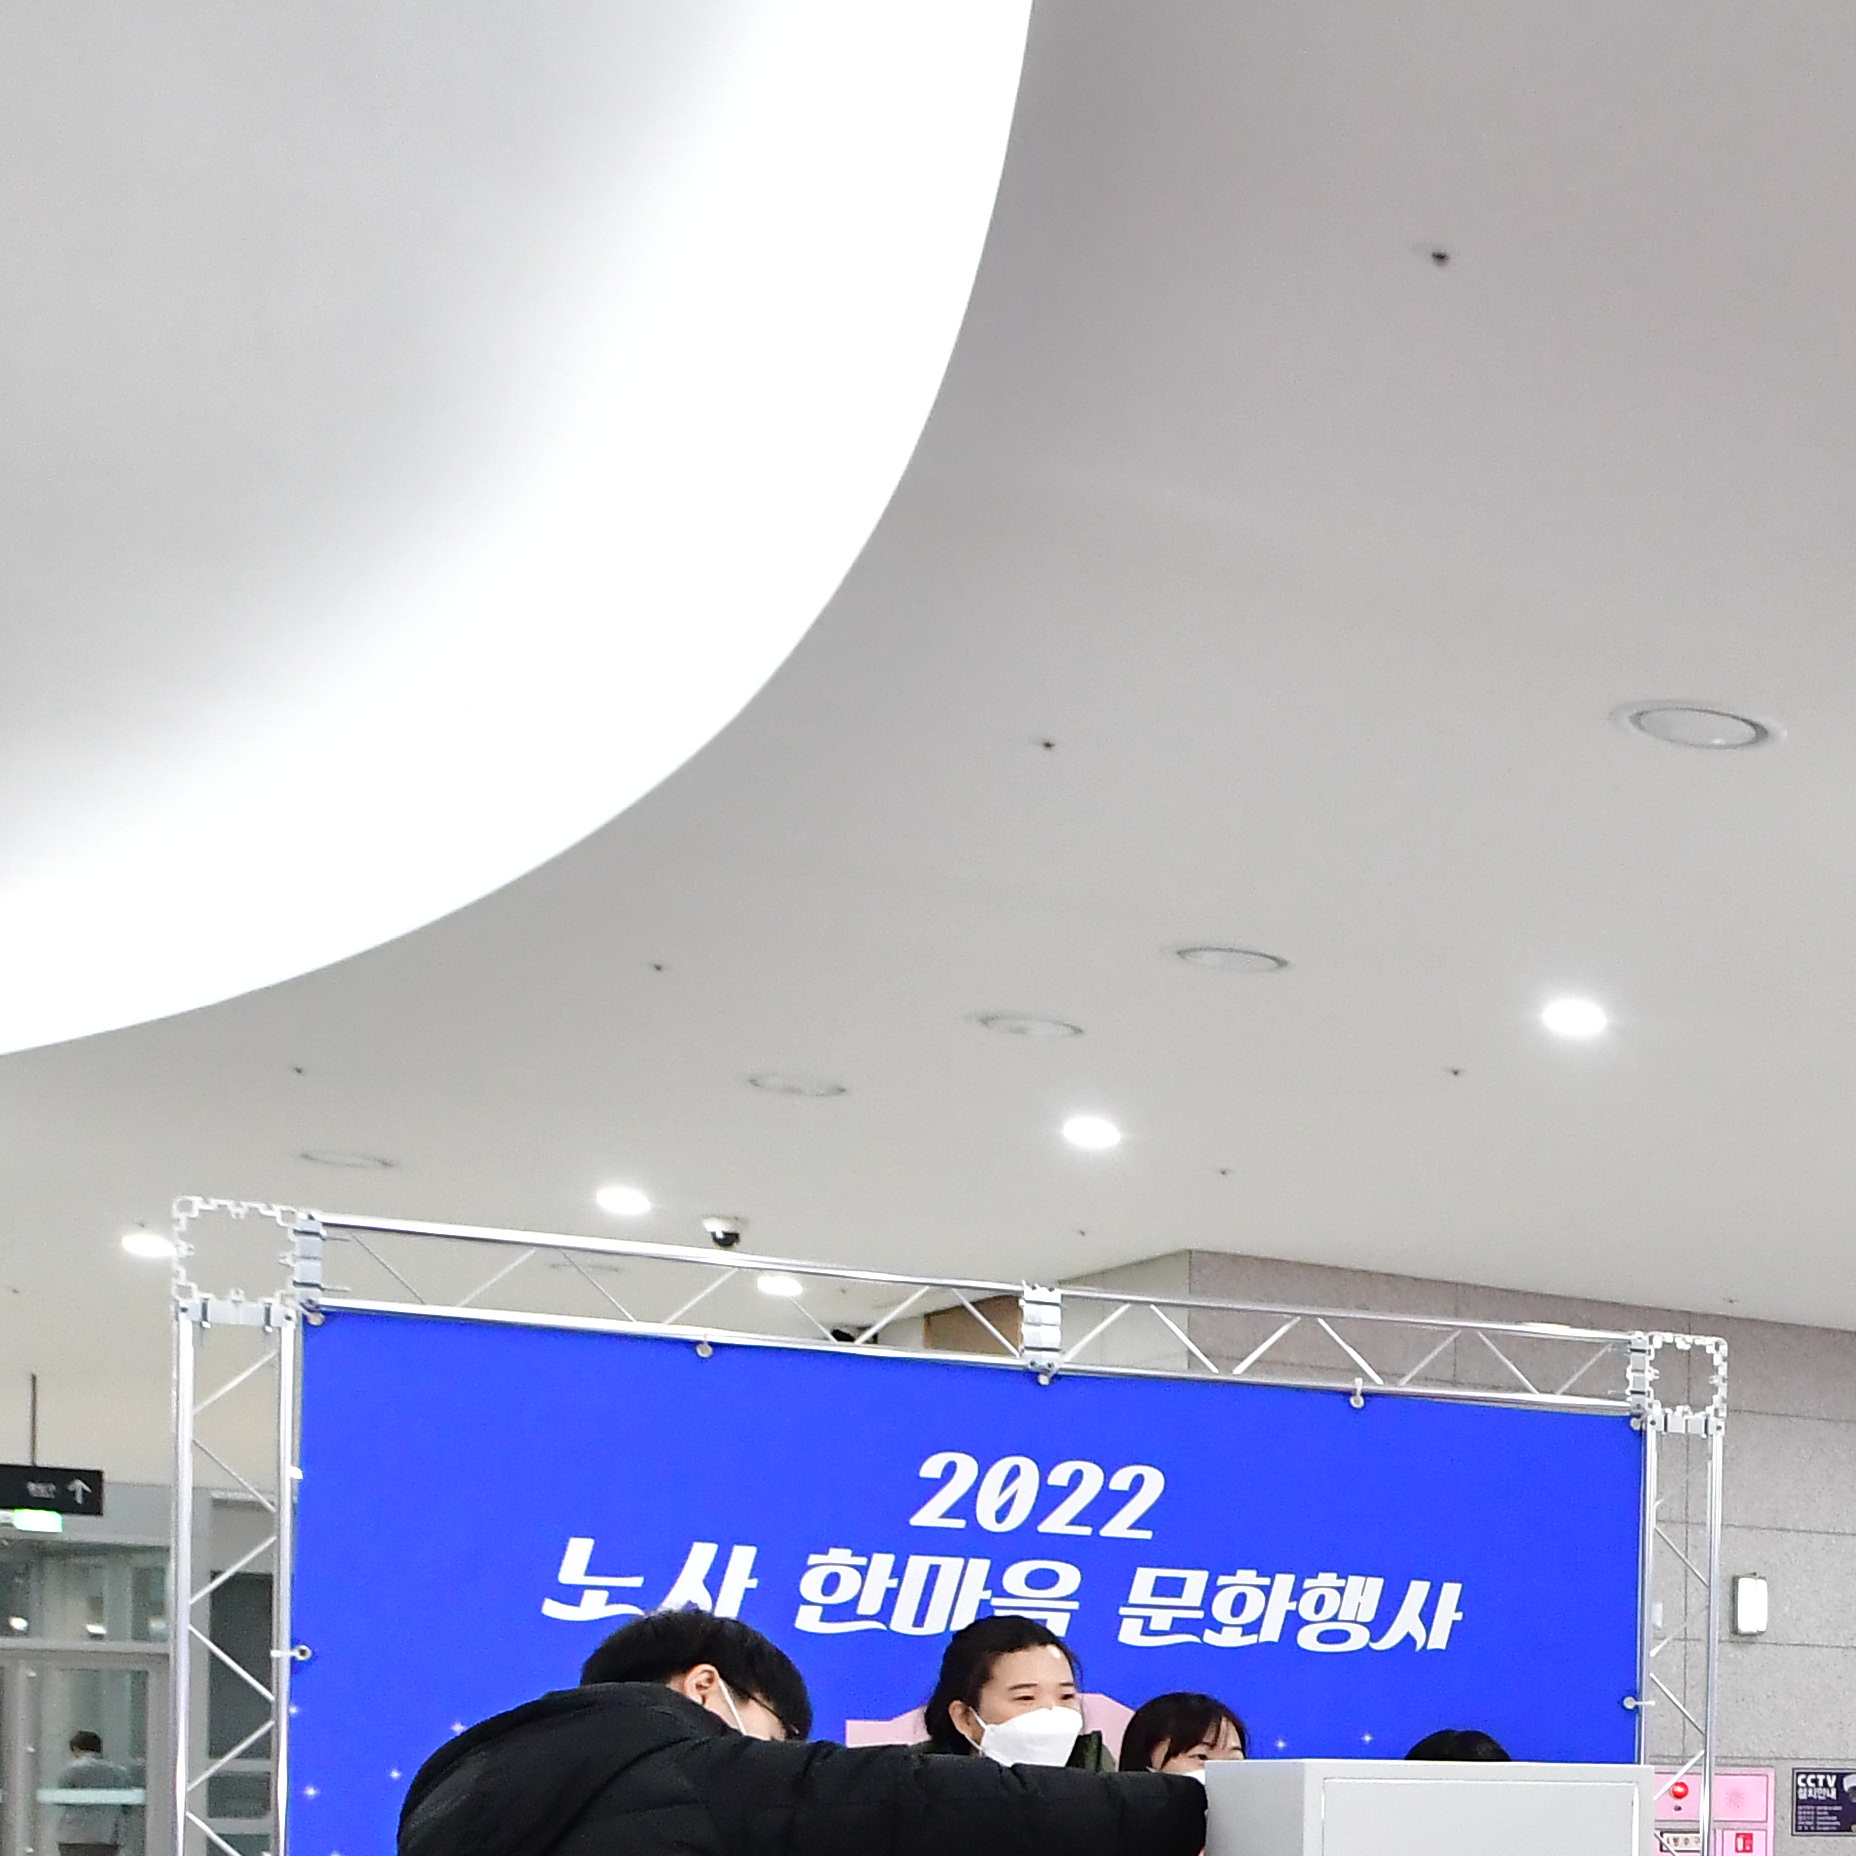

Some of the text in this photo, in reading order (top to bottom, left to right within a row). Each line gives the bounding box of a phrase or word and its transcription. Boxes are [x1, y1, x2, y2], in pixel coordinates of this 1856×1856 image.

[908, 1451, 1166, 1540] 2022
[541, 1537, 1464, 1654] 노사 한마음 문화행사
[1797, 1774, 1837, 1788] CCTV
